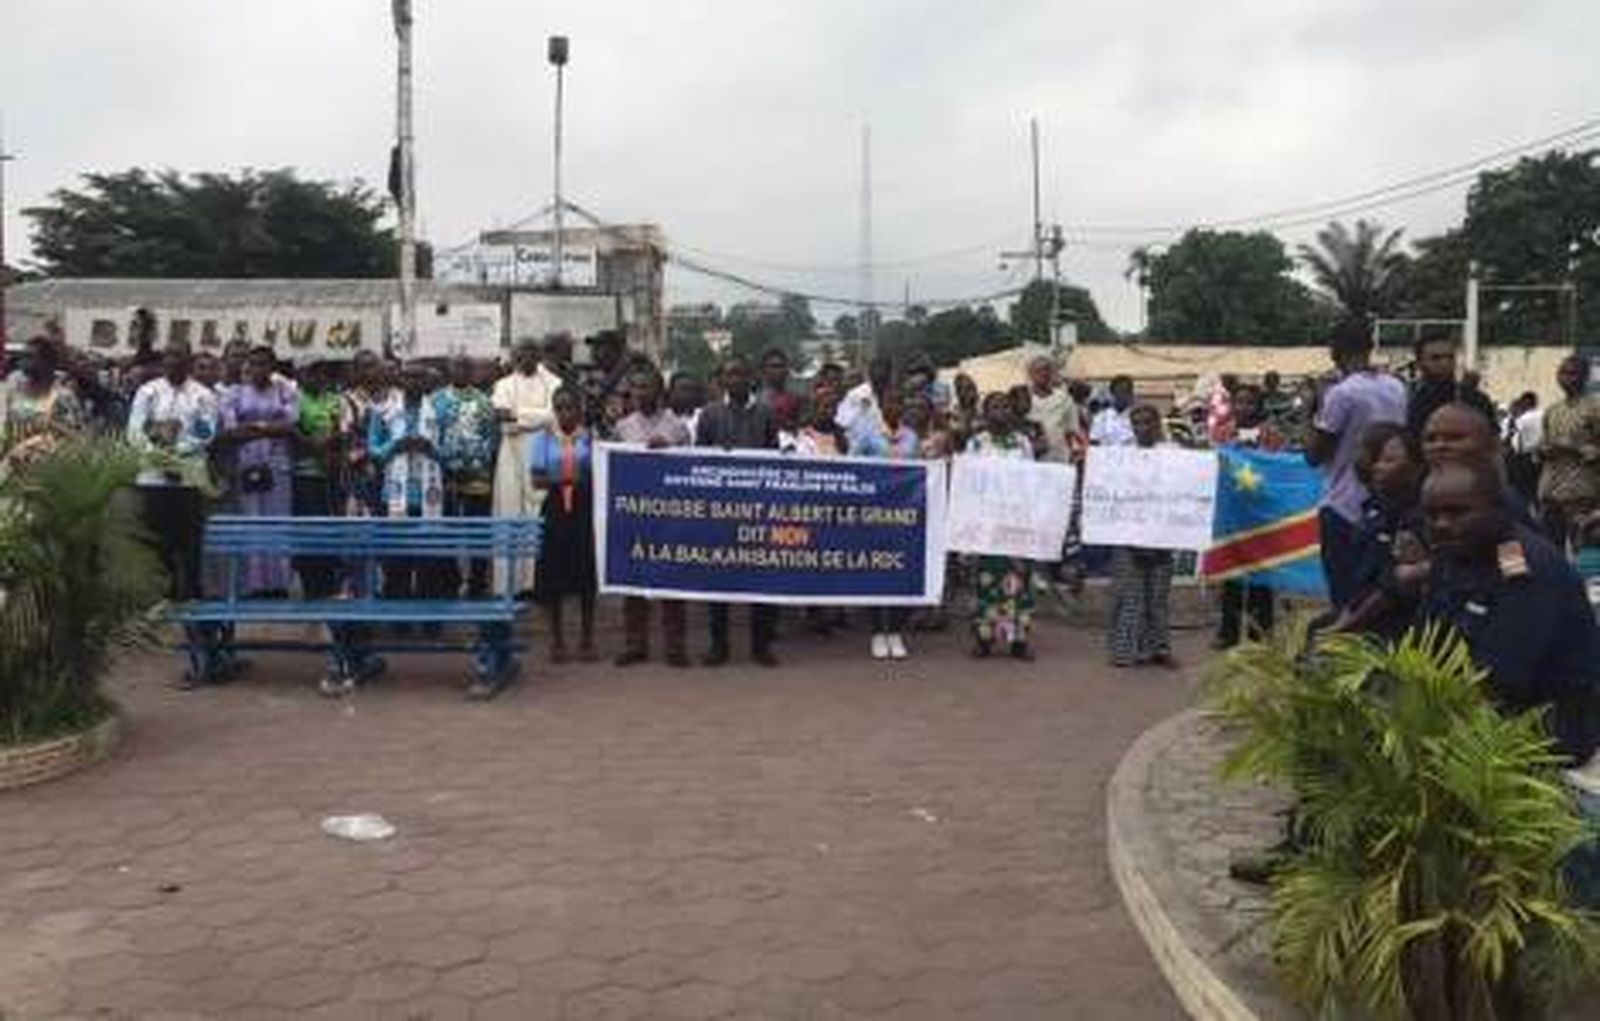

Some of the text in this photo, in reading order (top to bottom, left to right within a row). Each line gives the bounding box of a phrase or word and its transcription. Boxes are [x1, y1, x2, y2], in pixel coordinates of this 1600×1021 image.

[614, 495, 918, 525] PAROISSE SAINT ALBERT LE GRAND
[738, 525, 811, 545] DIT NON
[650, 545, 672, 561] LA
[675, 545, 818, 568] BALKANISATION
[821, 551, 845, 569] DE
[849, 551, 868, 569] LA
[871, 551, 905, 569] RDC
